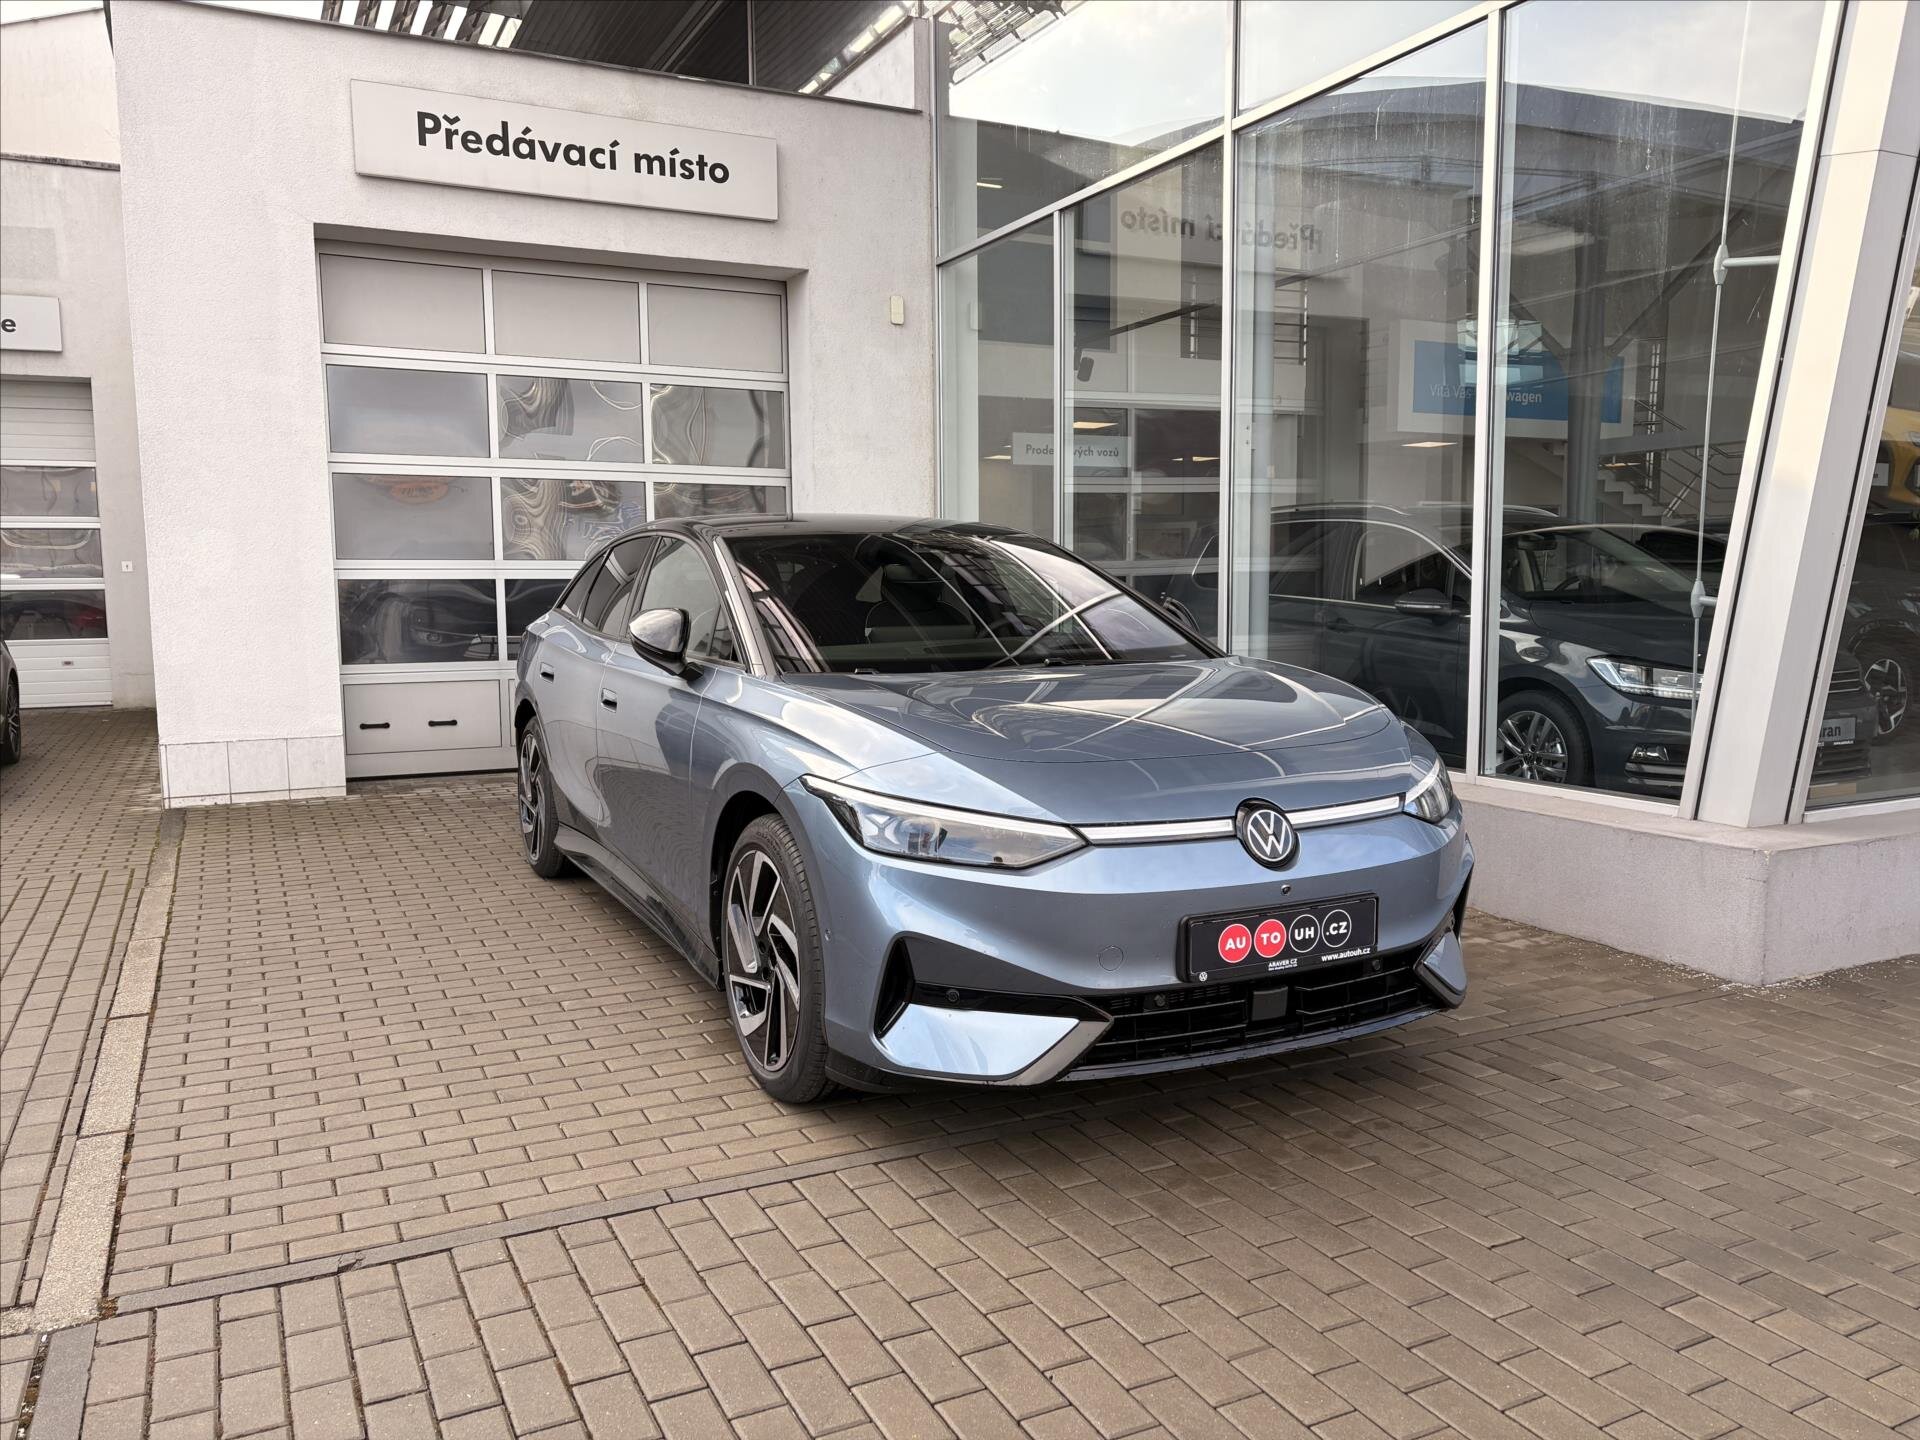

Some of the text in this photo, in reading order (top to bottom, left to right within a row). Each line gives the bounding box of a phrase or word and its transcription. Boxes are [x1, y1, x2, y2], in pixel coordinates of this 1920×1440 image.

[417, 111, 730, 184] Předávací místo
[1, 318, 17, 333] e
[1025, 443, 1054, 455] Prode
[1097, 447, 1119, 457] vozů
[1225, 937, 1246, 951] AU
[1260, 932, 1281, 945] TO
[1294, 926, 1315, 941] UH
